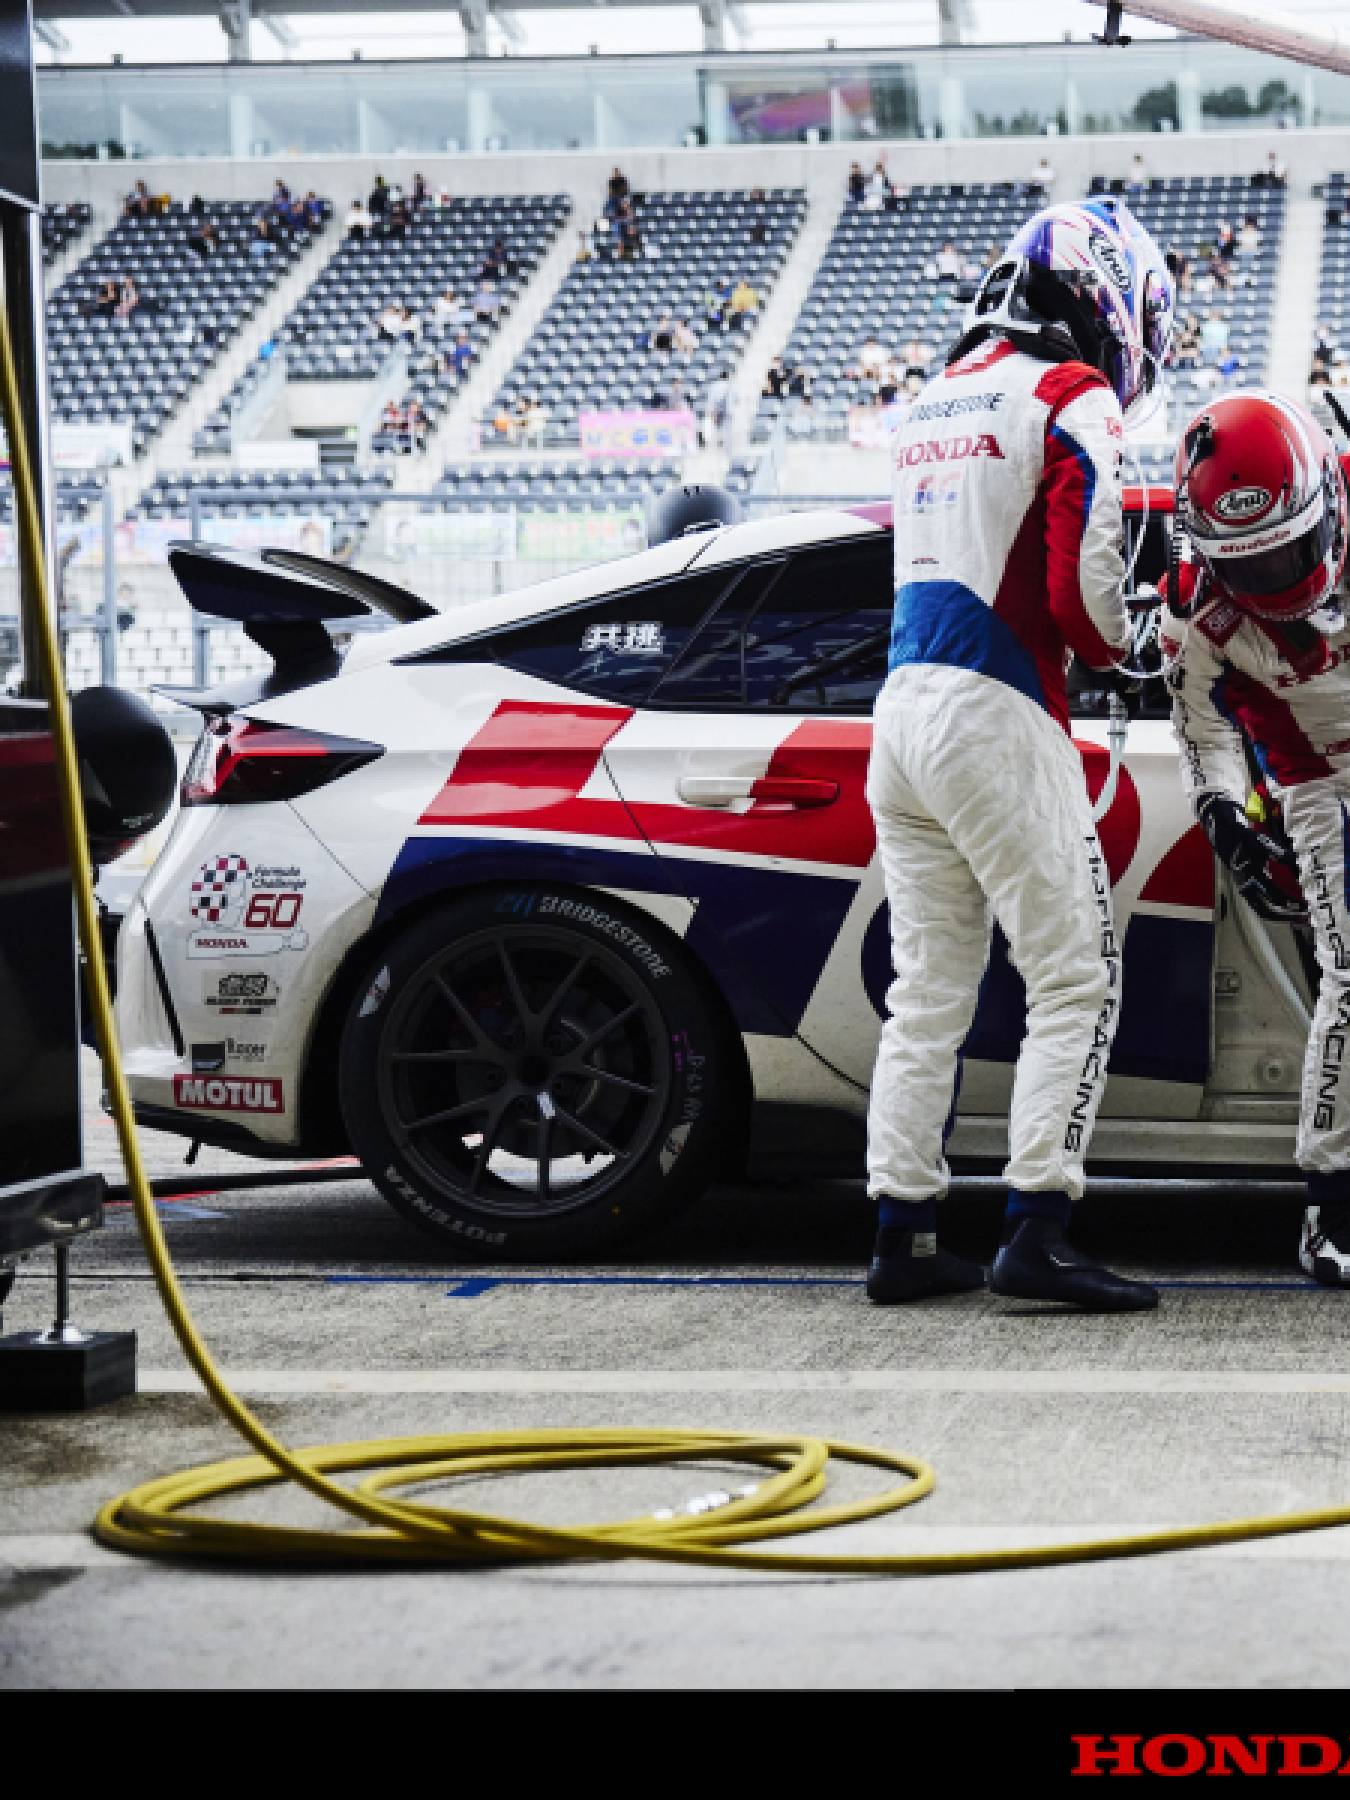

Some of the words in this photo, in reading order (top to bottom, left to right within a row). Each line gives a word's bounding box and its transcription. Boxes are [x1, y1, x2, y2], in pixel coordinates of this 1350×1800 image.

[244, 893, 304, 929] 60
[538, 895, 673, 979] BRIDGESTONE
[179, 1078, 280, 1109] MOTUL
[1065, 997, 1118, 1153] RACING
